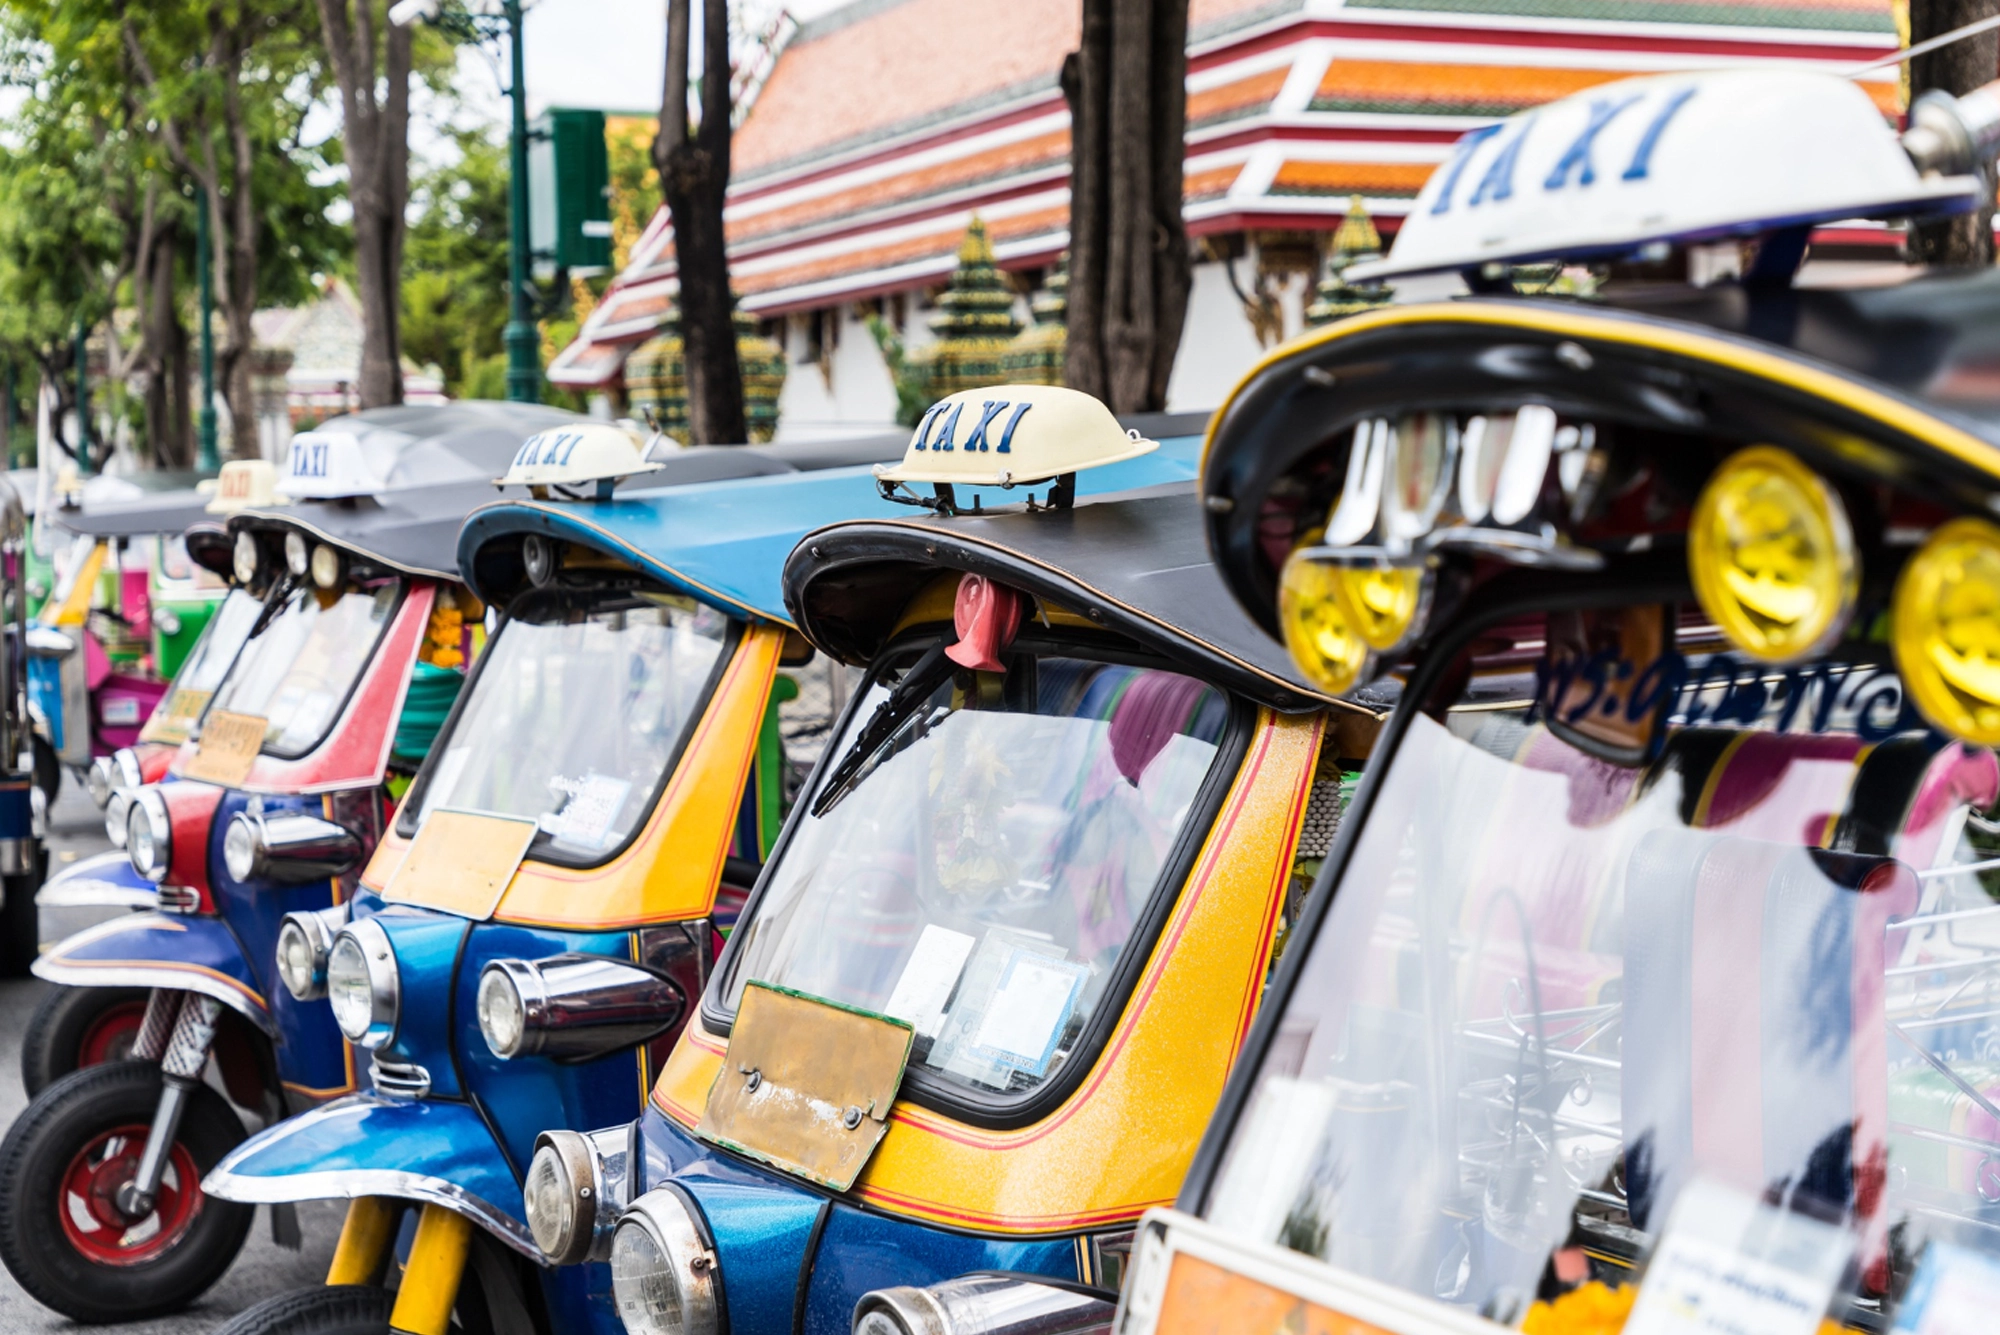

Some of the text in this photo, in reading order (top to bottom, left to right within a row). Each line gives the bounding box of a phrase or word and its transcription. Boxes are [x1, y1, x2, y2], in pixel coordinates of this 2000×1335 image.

[1430, 87, 1697, 215] TAXI
[915, 401, 1033, 453] TAXI
[293, 444, 328, 476] TAXI
[516, 433, 584, 466] TAXI
